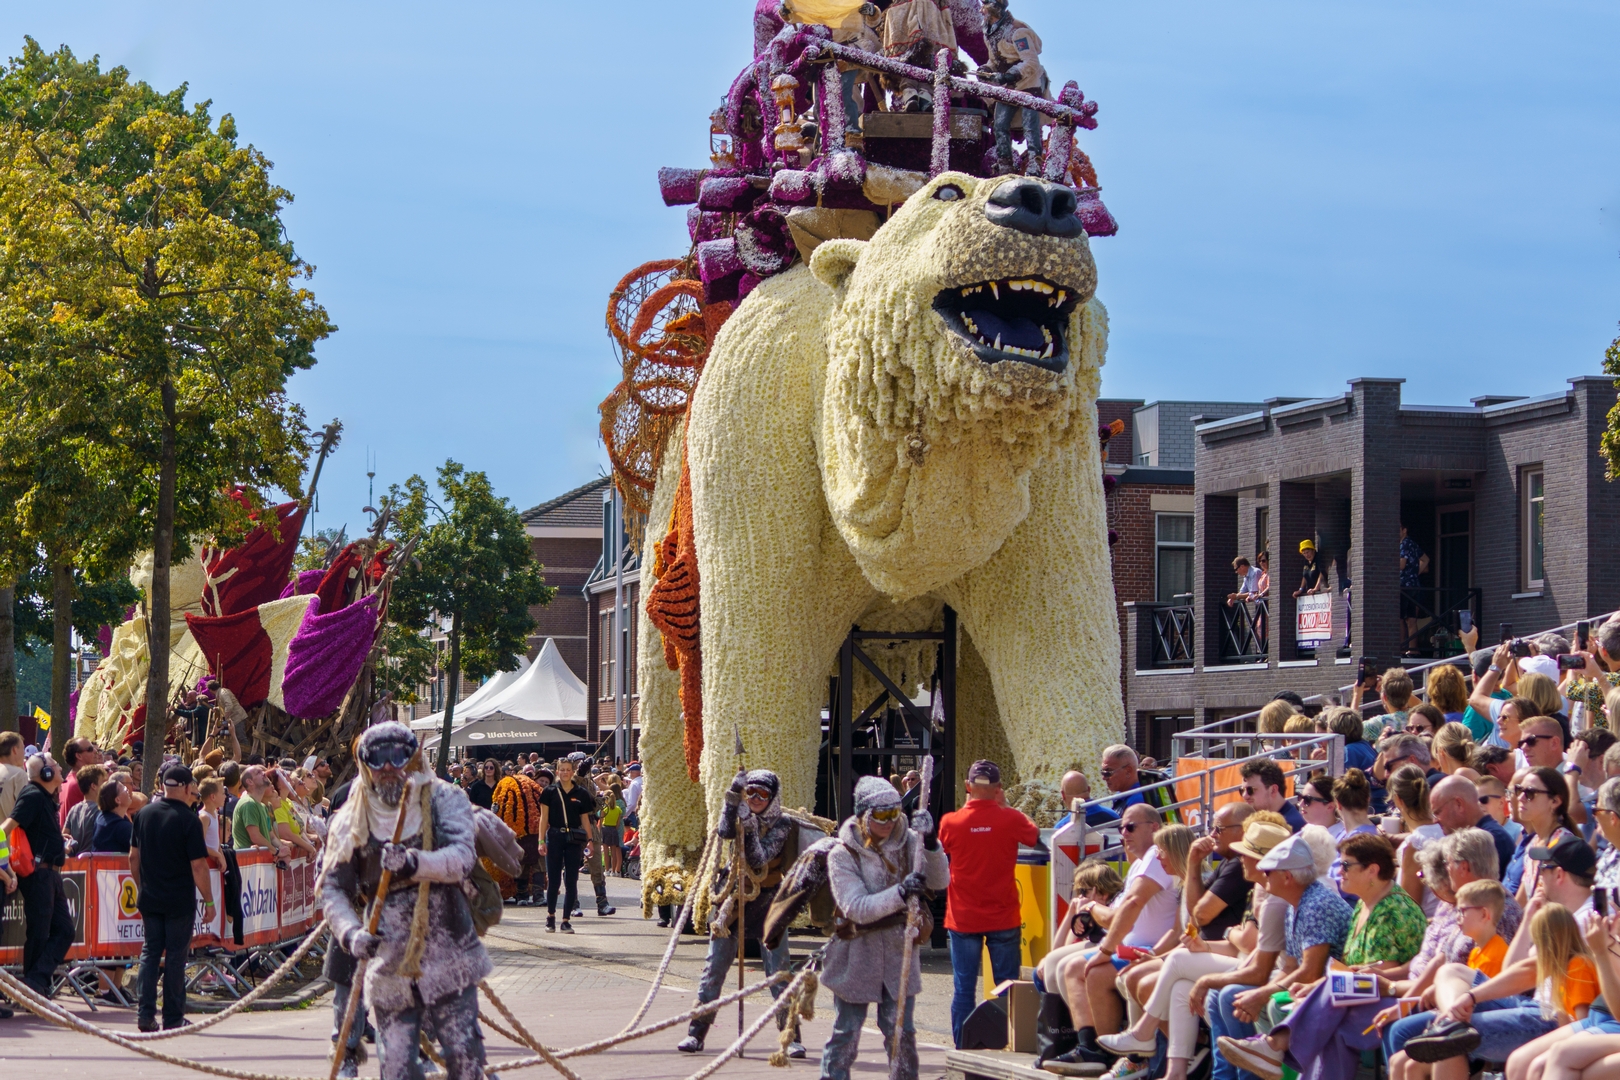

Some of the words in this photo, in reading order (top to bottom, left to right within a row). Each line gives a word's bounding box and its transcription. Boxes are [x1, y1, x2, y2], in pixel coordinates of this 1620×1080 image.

[487, 731, 538, 739] Warsteiner
[241, 877, 278, 919] abobank
[117, 924, 134, 938] HET
